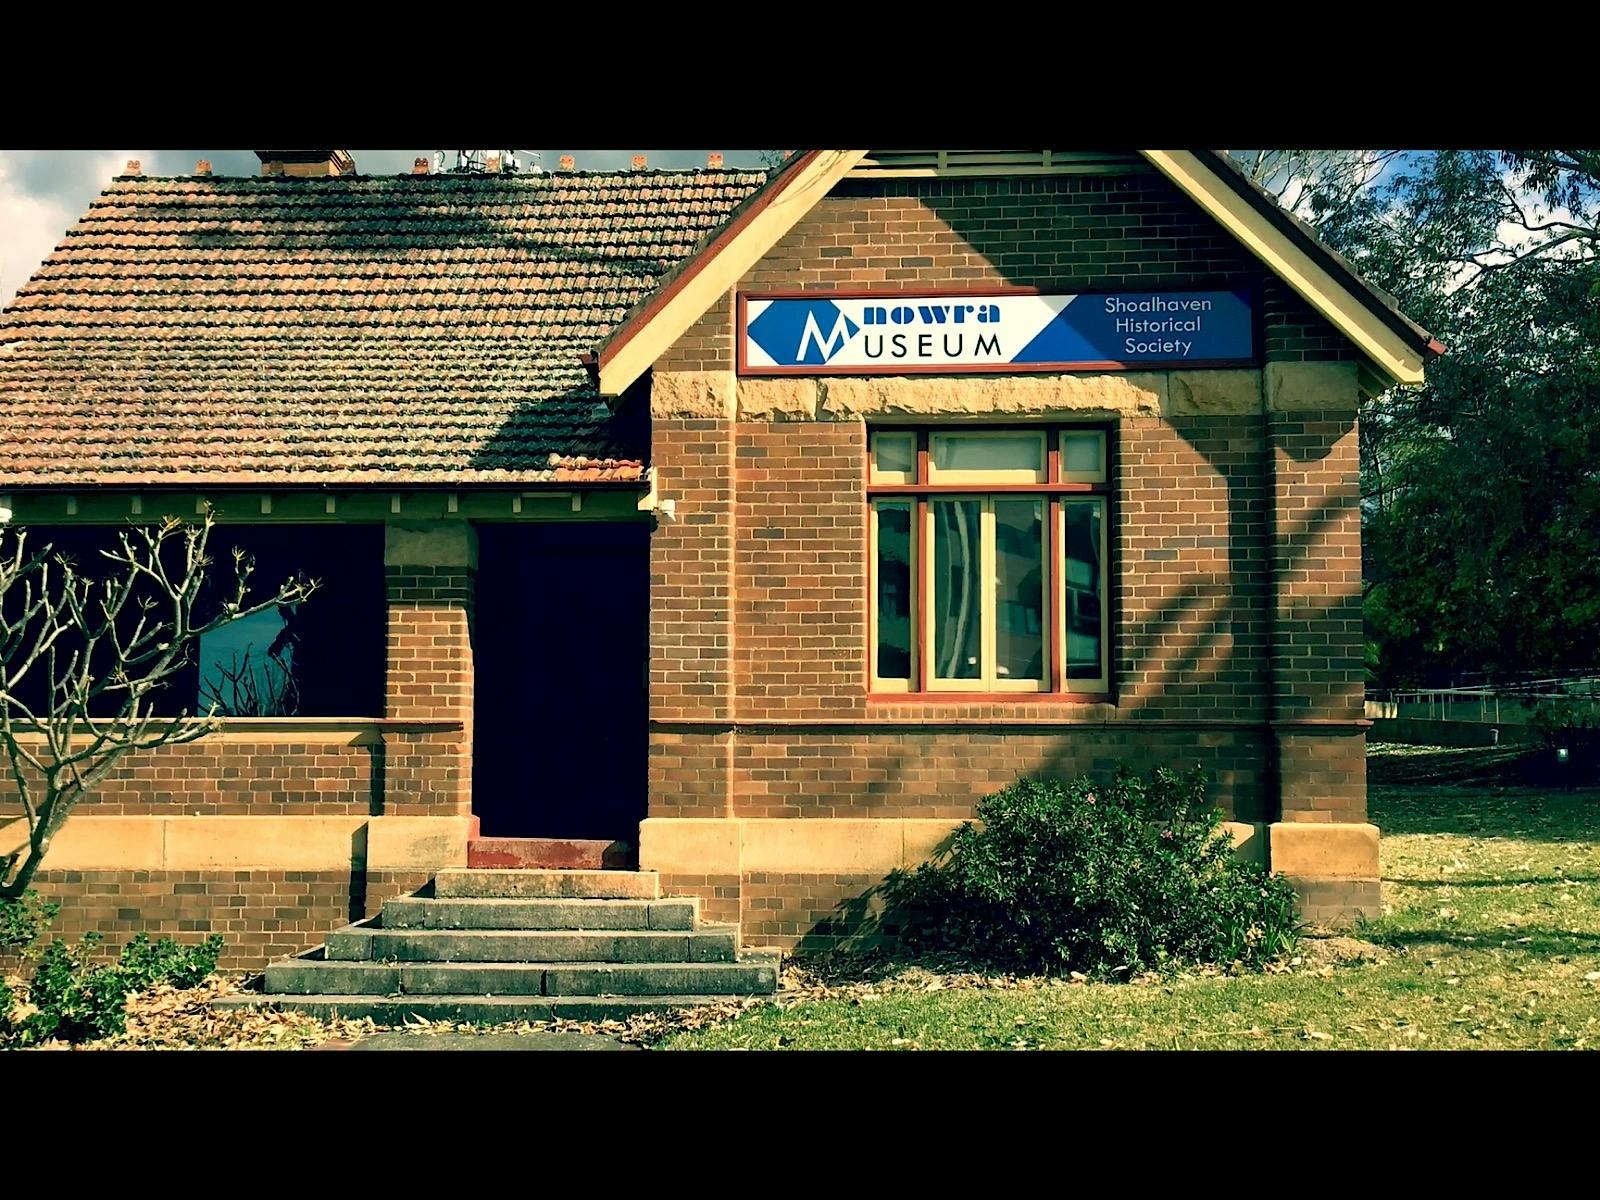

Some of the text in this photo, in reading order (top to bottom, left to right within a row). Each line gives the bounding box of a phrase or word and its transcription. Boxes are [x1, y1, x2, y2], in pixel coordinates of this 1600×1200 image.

[1105, 296, 1212, 313] Shoalhaven
[863, 304, 1001, 325] nowra
[1116, 315, 1201, 333] Historical
[1125, 337, 1192, 356] Society
